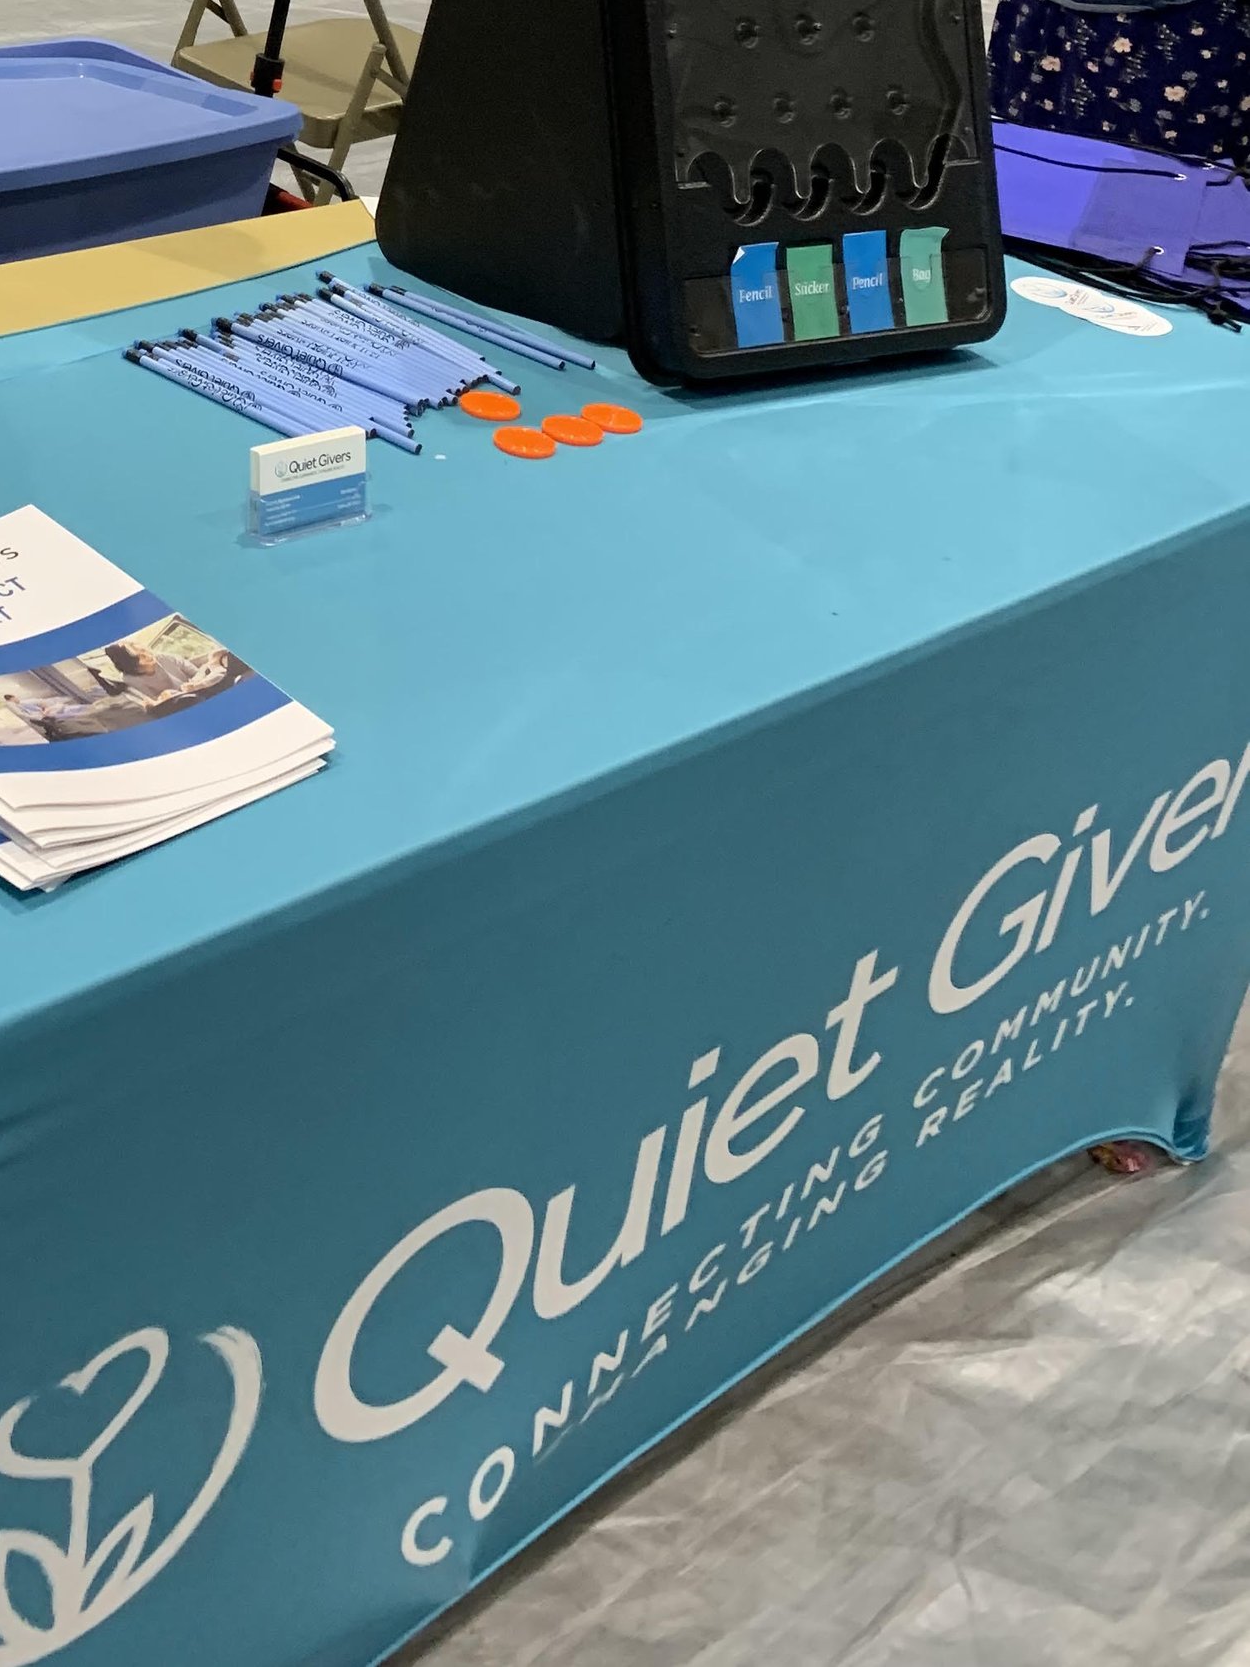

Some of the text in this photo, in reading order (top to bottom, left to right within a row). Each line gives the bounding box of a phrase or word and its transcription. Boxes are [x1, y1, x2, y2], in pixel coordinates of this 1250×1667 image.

[852, 272, 883, 289] Pencil
[257, 333, 296, 358] Givers
[289, 452, 351, 473] Quiet Givers
[915, 982, 1134, 1148] REALITY.
[314, 950, 898, 1443] Quiet
[400, 891, 1210, 1566] CONNECTING COMMUNITY.
